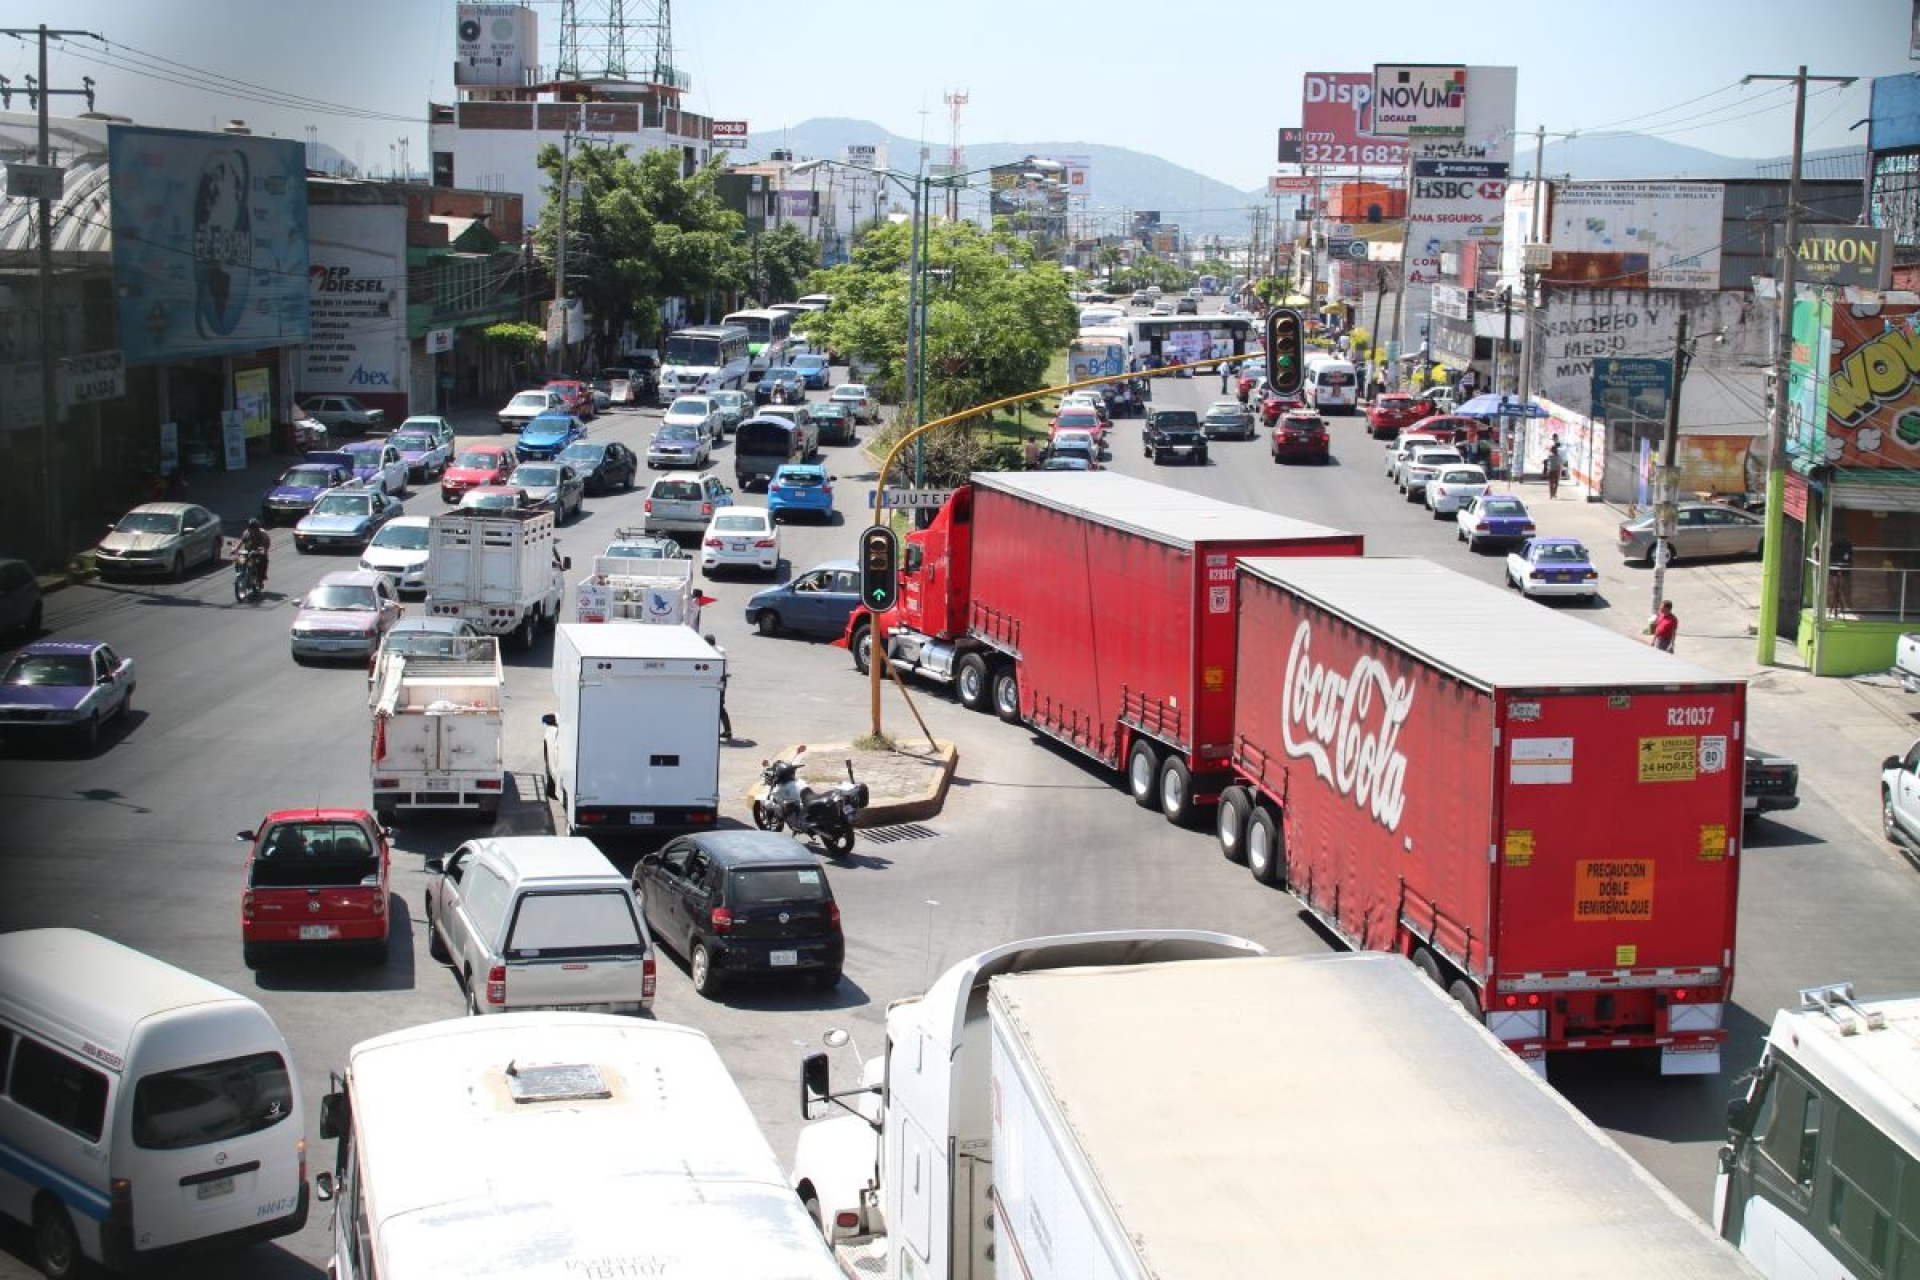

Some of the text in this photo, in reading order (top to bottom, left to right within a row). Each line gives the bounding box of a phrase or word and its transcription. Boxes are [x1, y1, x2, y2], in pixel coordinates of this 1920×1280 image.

[1306, 77, 1371, 112] Disp
[1380, 82, 1450, 108] NOVUM
[1379, 114, 1417, 122] LOCALES
[1306, 131, 1335, 143] (777)
[1305, 144, 1408, 163] 3221682
[1423, 141, 1486, 158] NOVUM
[1416, 181, 1474, 199] HSBC
[1411, 214, 1484, 223] ANA SEGUROS
[1798, 238, 1878, 265] ATRON
[324, 280, 385, 293] DIESEL
[1646, 309, 1659, 326] Y
[1667, 706, 1714, 726] R21037
[1662, 739, 1695, 747] UNIDAD
[1674, 752, 1694, 761] GPS
[1705, 751, 1717, 762] 80
[1643, 761, 1695, 772] 24 HORAS
[1587, 861, 1646, 878] PRECAUCIÓN
[1599, 881, 1629, 897] DOBLE
[1578, 900, 1650, 915] SEMIREMOLQUE
